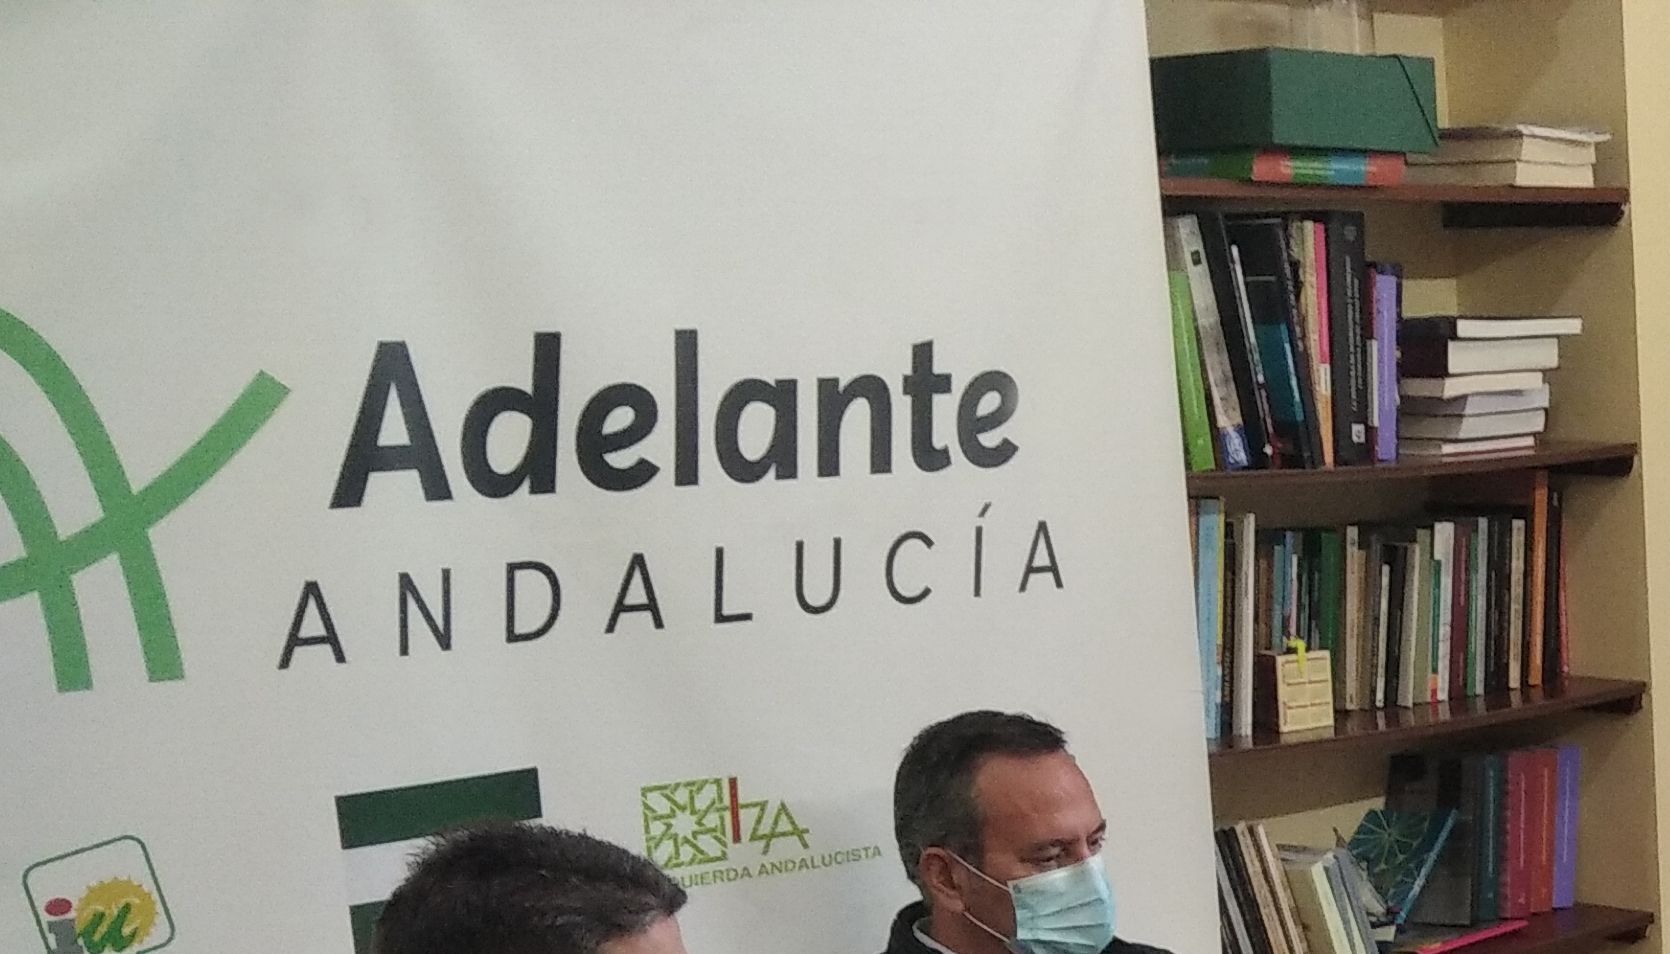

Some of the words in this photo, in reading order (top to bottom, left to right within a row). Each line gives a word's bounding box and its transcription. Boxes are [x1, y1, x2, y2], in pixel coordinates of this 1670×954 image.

[330, 328, 1019, 510] Adelante
[278, 502, 1064, 670] ANDALUCÍA
[680, 865, 752, 889] UIERDA
[757, 845, 882, 877] ANDALUCISTA
